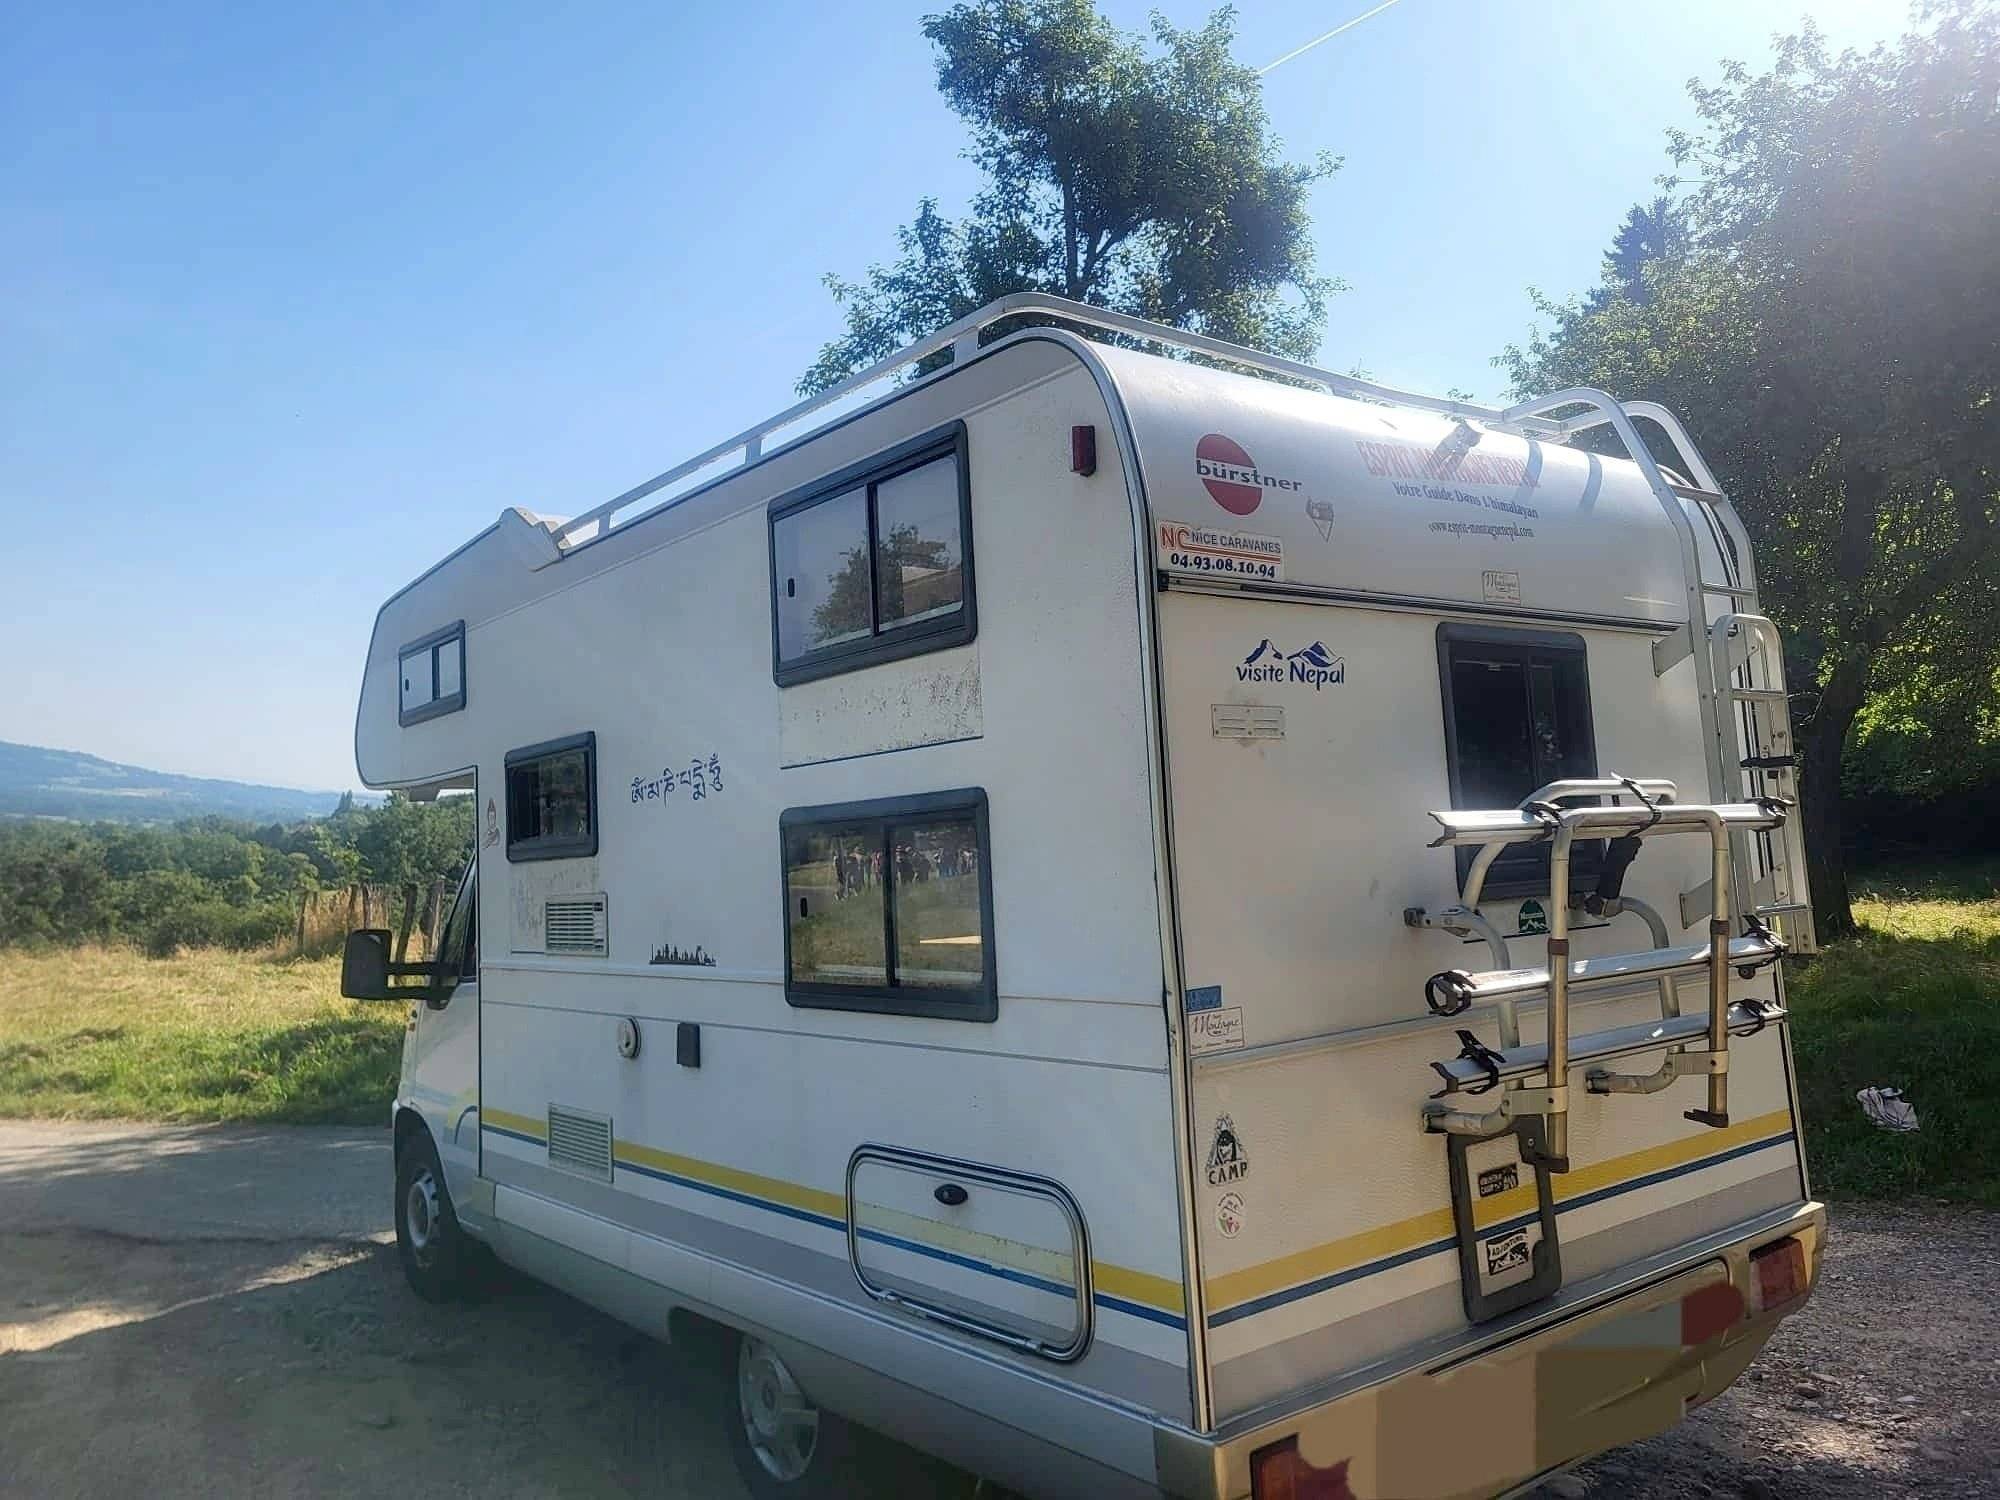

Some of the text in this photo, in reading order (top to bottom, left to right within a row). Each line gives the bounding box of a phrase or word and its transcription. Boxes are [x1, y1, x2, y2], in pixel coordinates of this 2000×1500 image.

[1196, 459, 1303, 492] bürstner
[1392, 481, 1422, 498] Votre
[1422, 484, 1455, 502] Guide
[1455, 489, 1482, 507] Dans
[1161, 525, 1281, 554] NC NICE CARAVANES
[1171, 553, 1275, 579] 04.93.08.10.94
[1236, 661, 1345, 691] visite Nepal
[1208, 1162, 1248, 1185] CAMP
